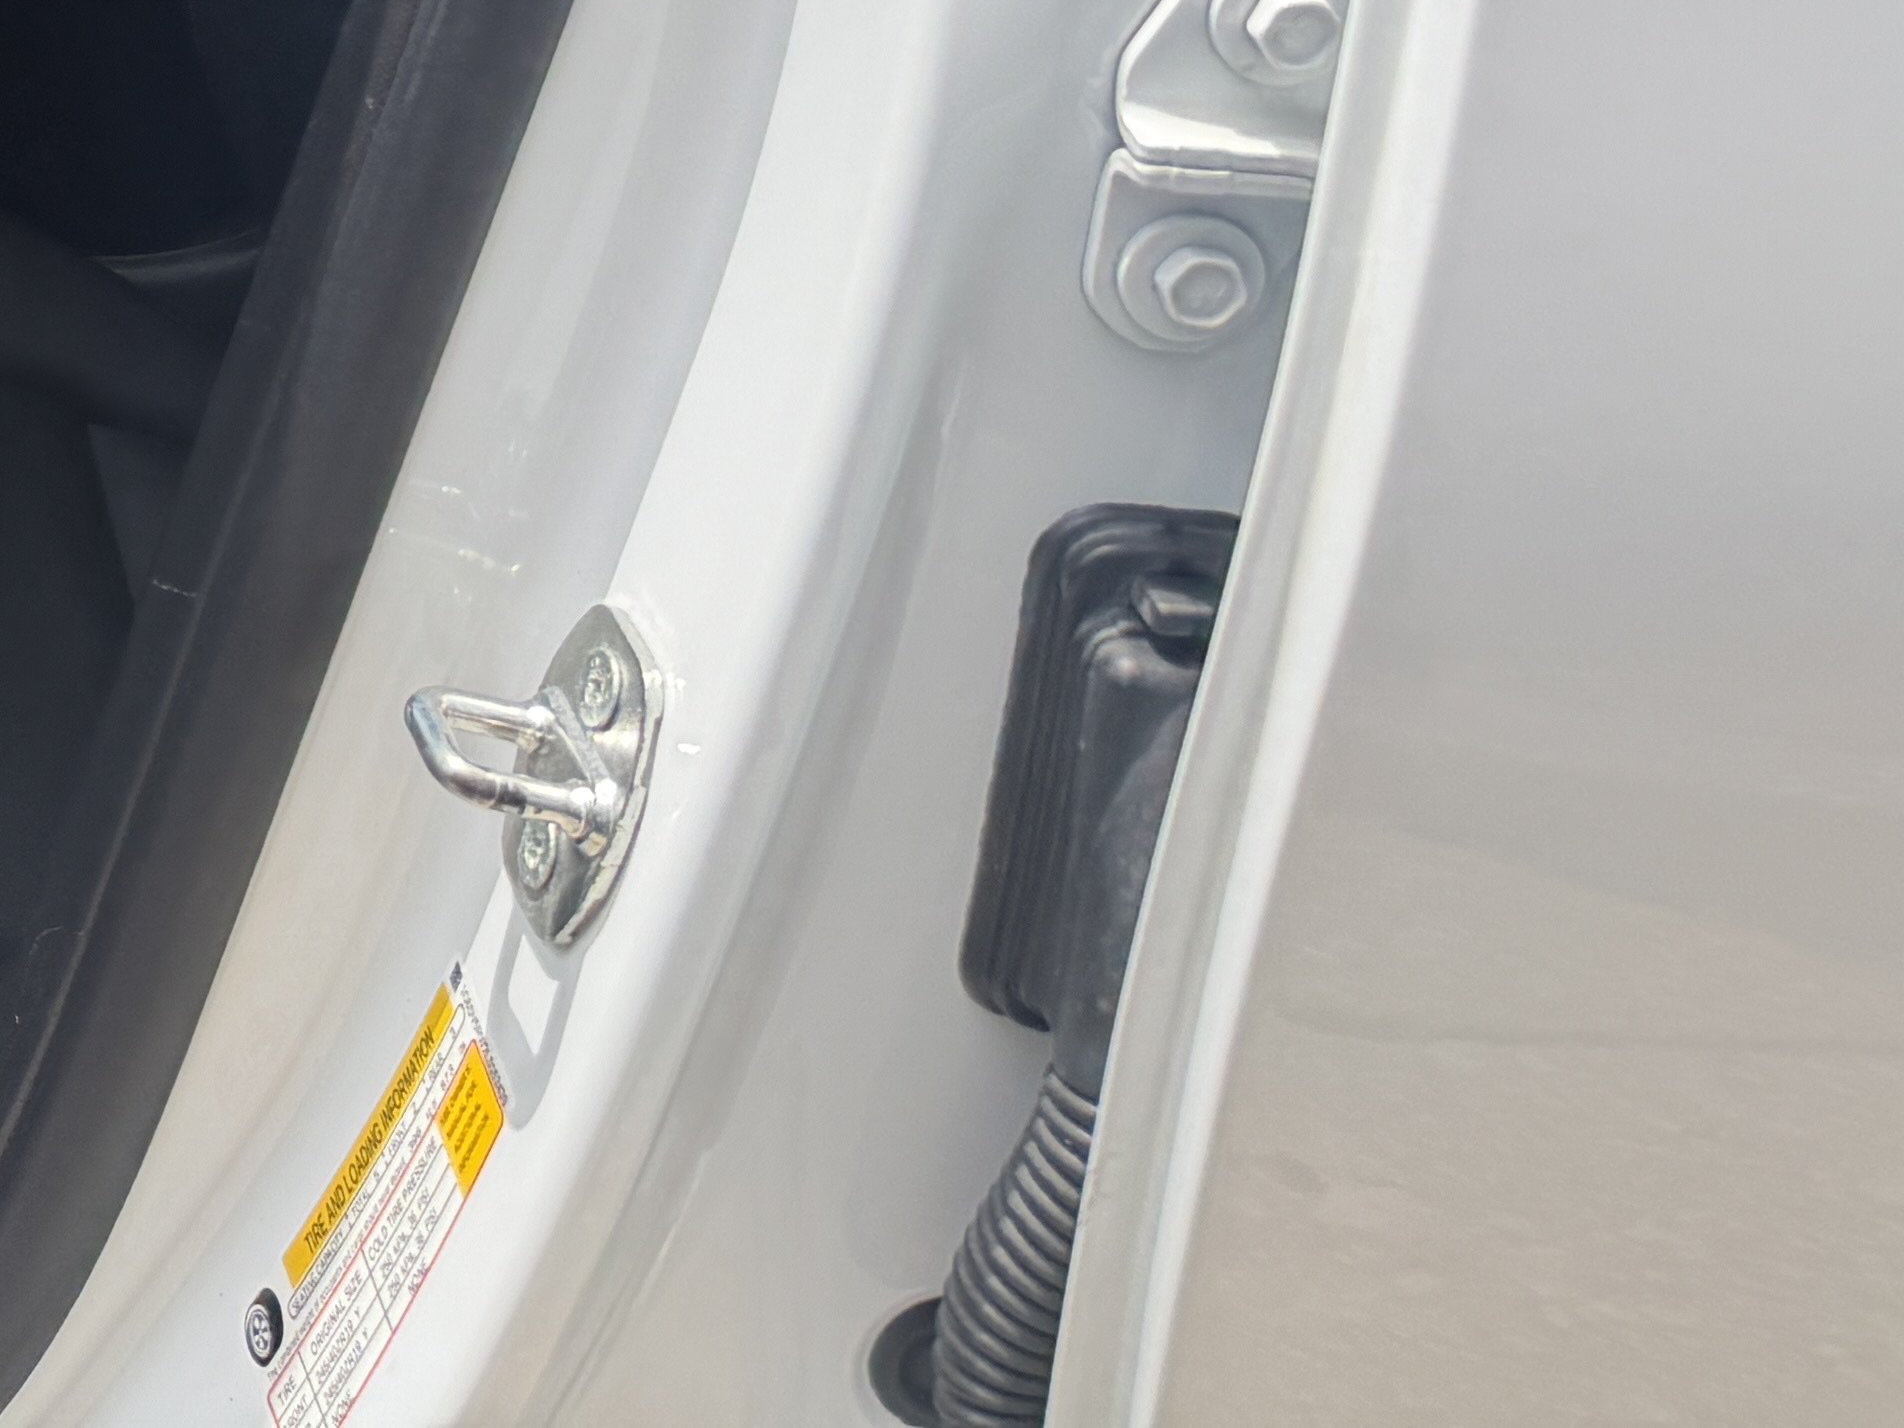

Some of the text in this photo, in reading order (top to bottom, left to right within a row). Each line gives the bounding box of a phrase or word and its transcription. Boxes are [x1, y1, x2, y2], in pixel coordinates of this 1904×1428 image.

[304, 1025, 435, 1254] TIRE AND LOADING INFORMATION
[368, 1136, 437, 1261] COLD TIRE PRESSURE
[310, 1270, 362, 1355] ORIGINAL SIZE
[407, 1258, 428, 1295] NONE
[277, 1374, 297, 1405] TIRE
